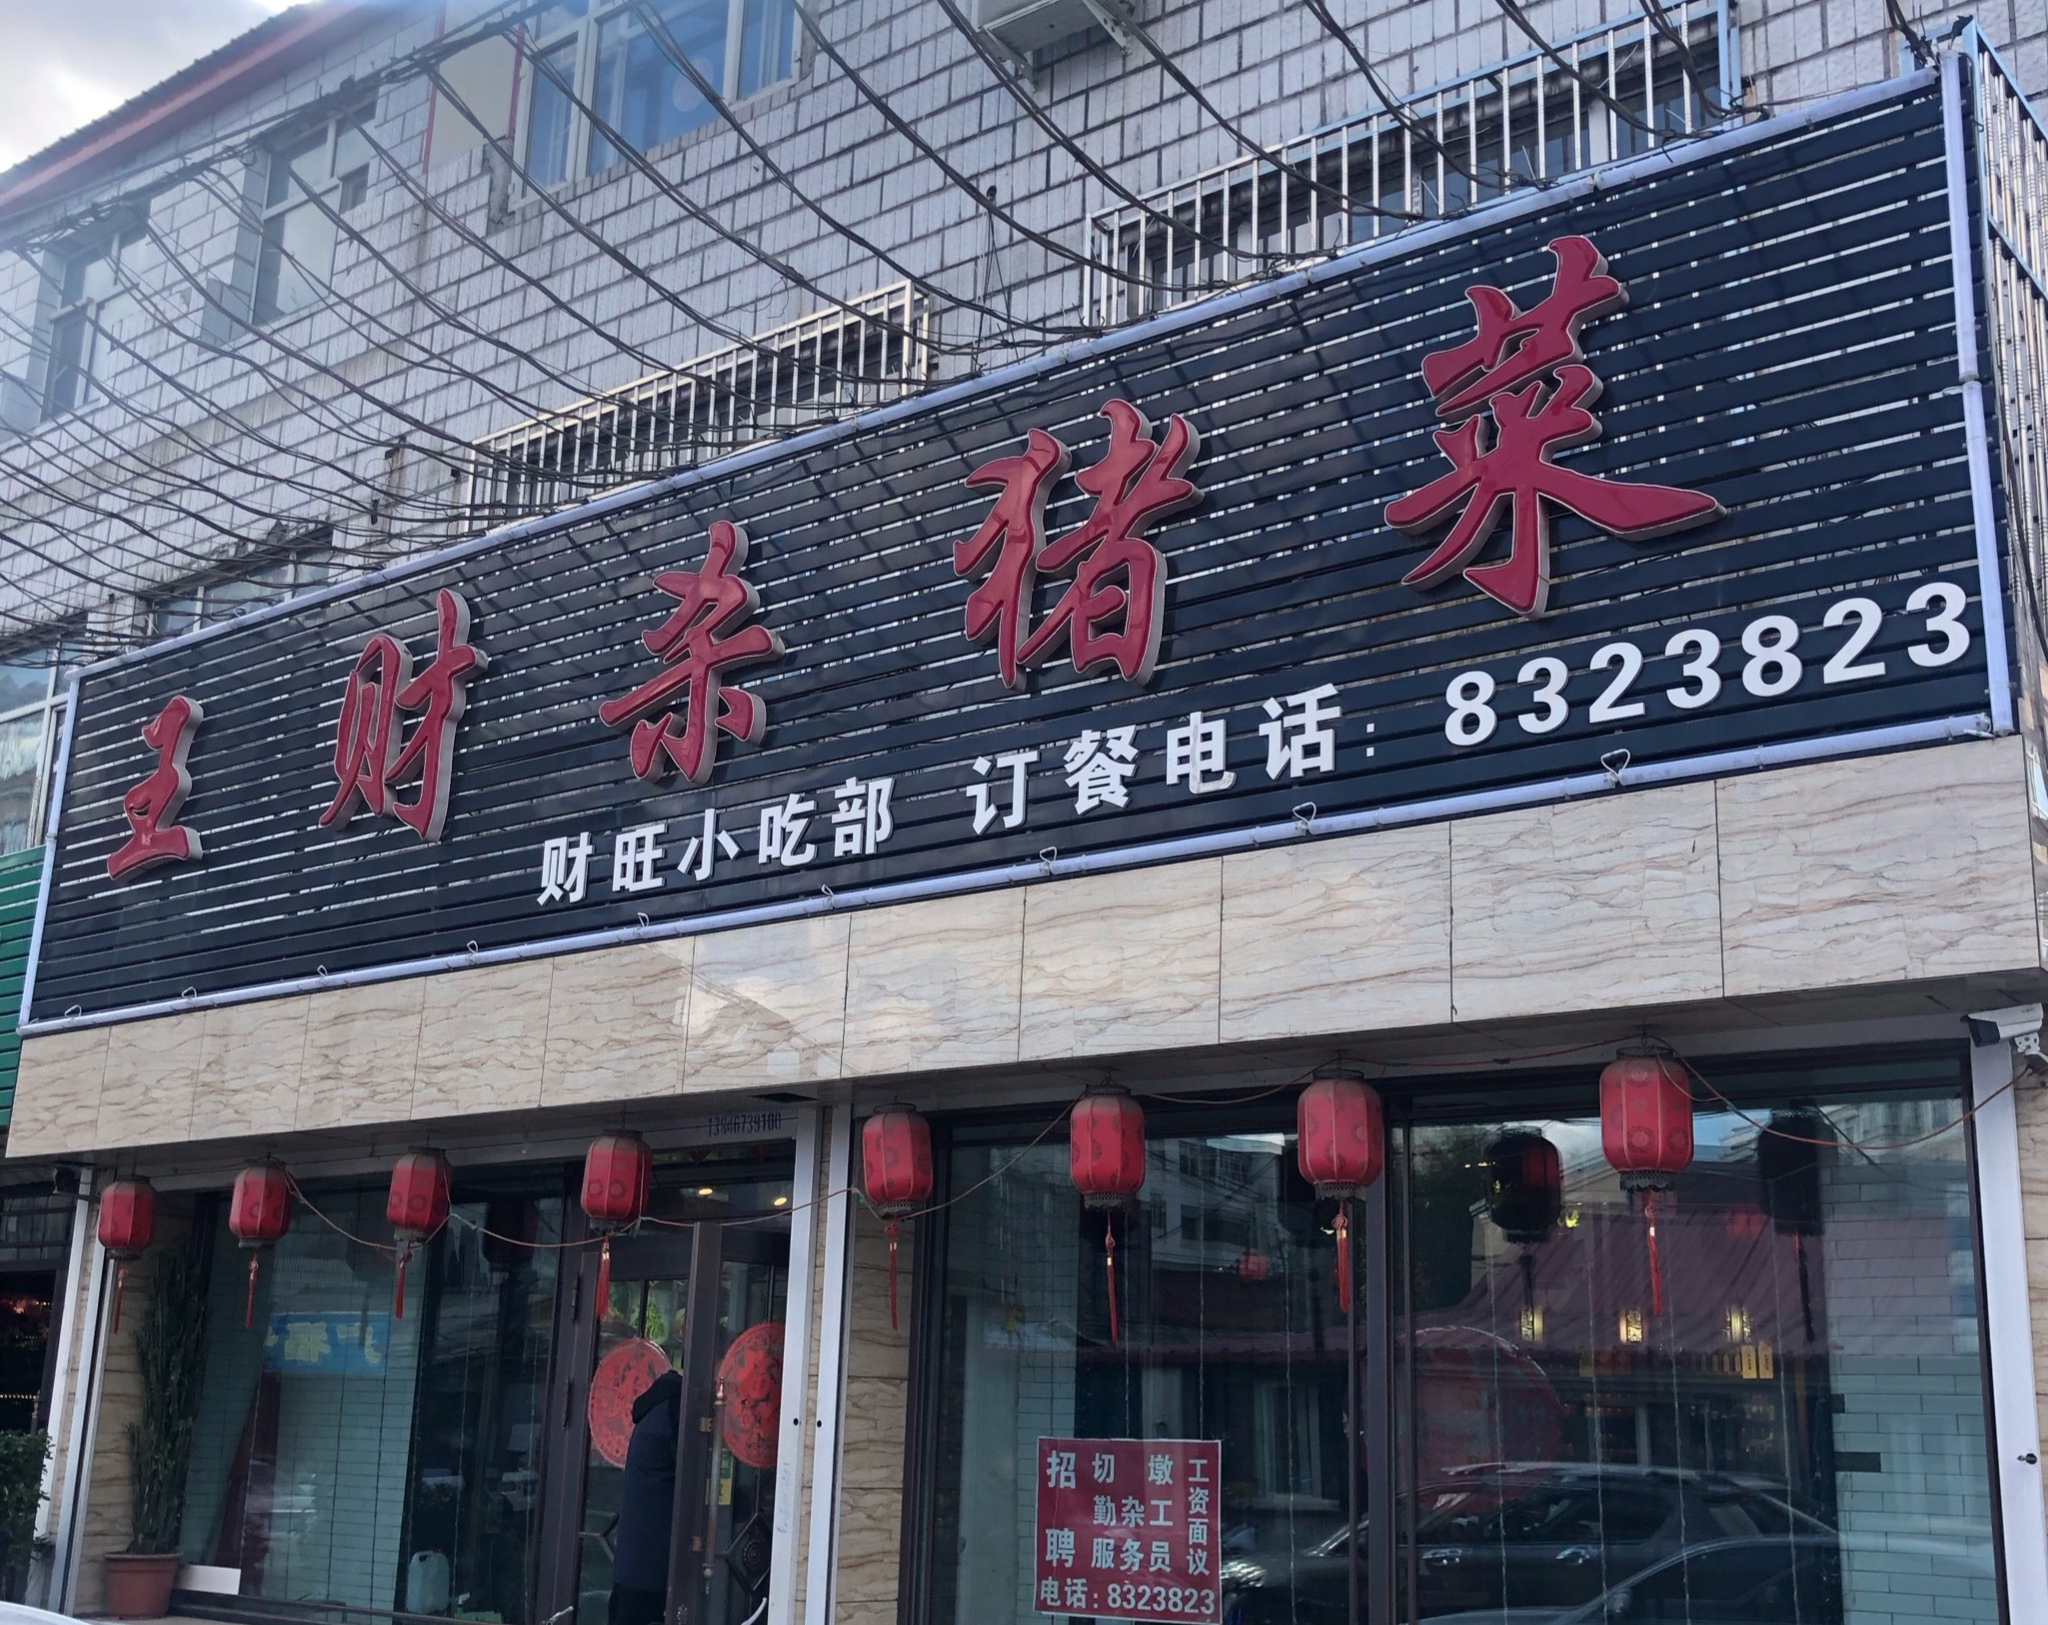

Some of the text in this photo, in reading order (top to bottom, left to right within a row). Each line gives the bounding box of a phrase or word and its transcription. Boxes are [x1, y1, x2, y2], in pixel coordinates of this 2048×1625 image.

[537, 777, 897, 907] 财旺小吃部
[1093, 1495, 1174, 1527] 勤杂工
[1187, 1459, 1210, 1576] 工资面议
[1091, 1538, 1171, 1573] 服务员
